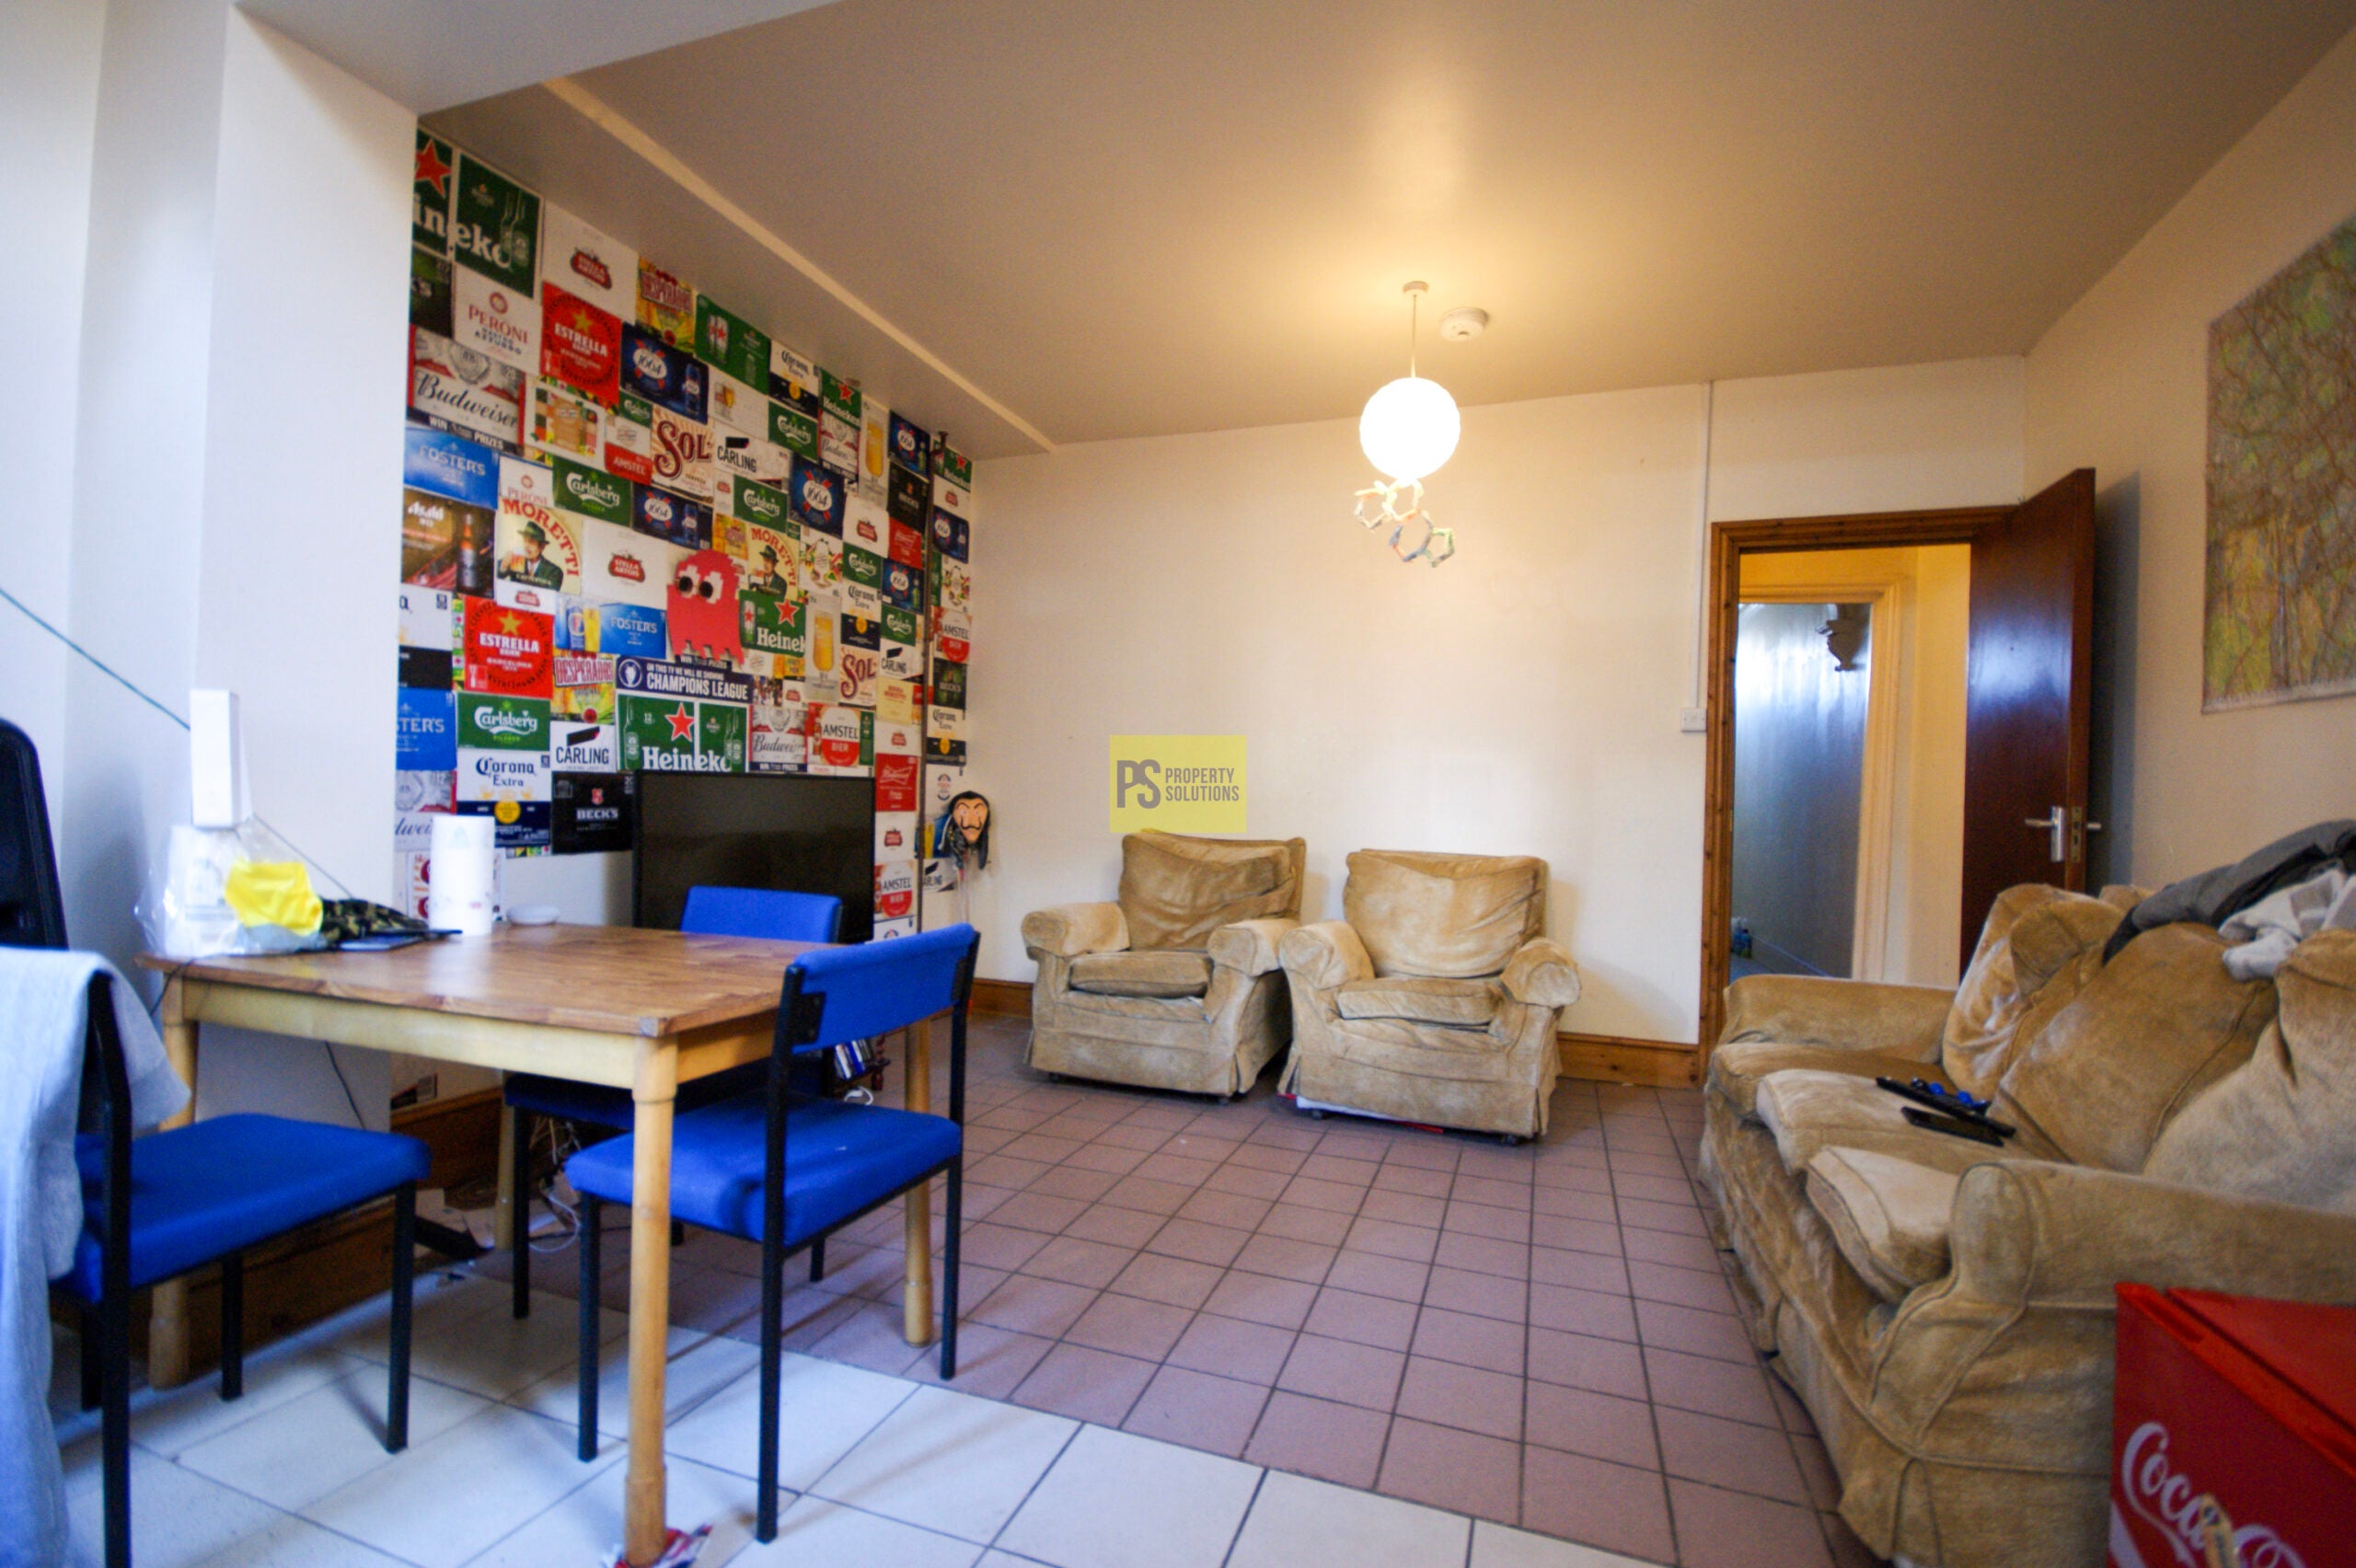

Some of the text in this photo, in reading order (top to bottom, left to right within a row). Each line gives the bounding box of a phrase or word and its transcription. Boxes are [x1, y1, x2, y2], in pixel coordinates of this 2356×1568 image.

[468, 304, 528, 344] PERONI
[554, 322, 608, 357] ESTRELLA
[417, 372, 518, 428] Budweiser
[428, 415, 448, 431] WIN
[474, 431, 504, 450] PRIZES
[777, 415, 812, 444] Carlsberg
[613, 456, 646, 475] AMSTEL
[717, 445, 756, 473] CARLING
[507, 486, 549, 505] PERONI
[566, 472, 621, 507] Carlsberg
[805, 489, 828, 508] 1664
[743, 489, 780, 517] Carlsberg
[502, 498, 580, 577] MORETTI
[614, 559, 639, 571] STELLA
[750, 527, 797, 587] MORETTI
[614, 567, 640, 578] ARTOIS
[849, 584, 875, 603] Corona
[886, 614, 913, 635] Carlsberg
[942, 623, 969, 640] AMSTEL
[479, 632, 540, 653] ESTRELLA
[486, 656, 532, 669] BARCELONA
[554, 658, 615, 685] DESPERADOS
[881, 657, 907, 674] CARLING
[684, 668, 695, 677] WILL
[646, 673, 748, 701] CHAMPIONS LEAGUE
[397, 717, 445, 733] TER'S
[474, 706, 538, 735] Carlsberg
[823, 725, 858, 740] AMSTEL
[555, 746, 610, 765] CARLING
[831, 743, 849, 752] BIER
[476, 756, 537, 778] Corona
[492, 776, 524, 787] Extra
[576, 807, 618, 821] BECK'S
[883, 877, 911, 890] AMSTEL
